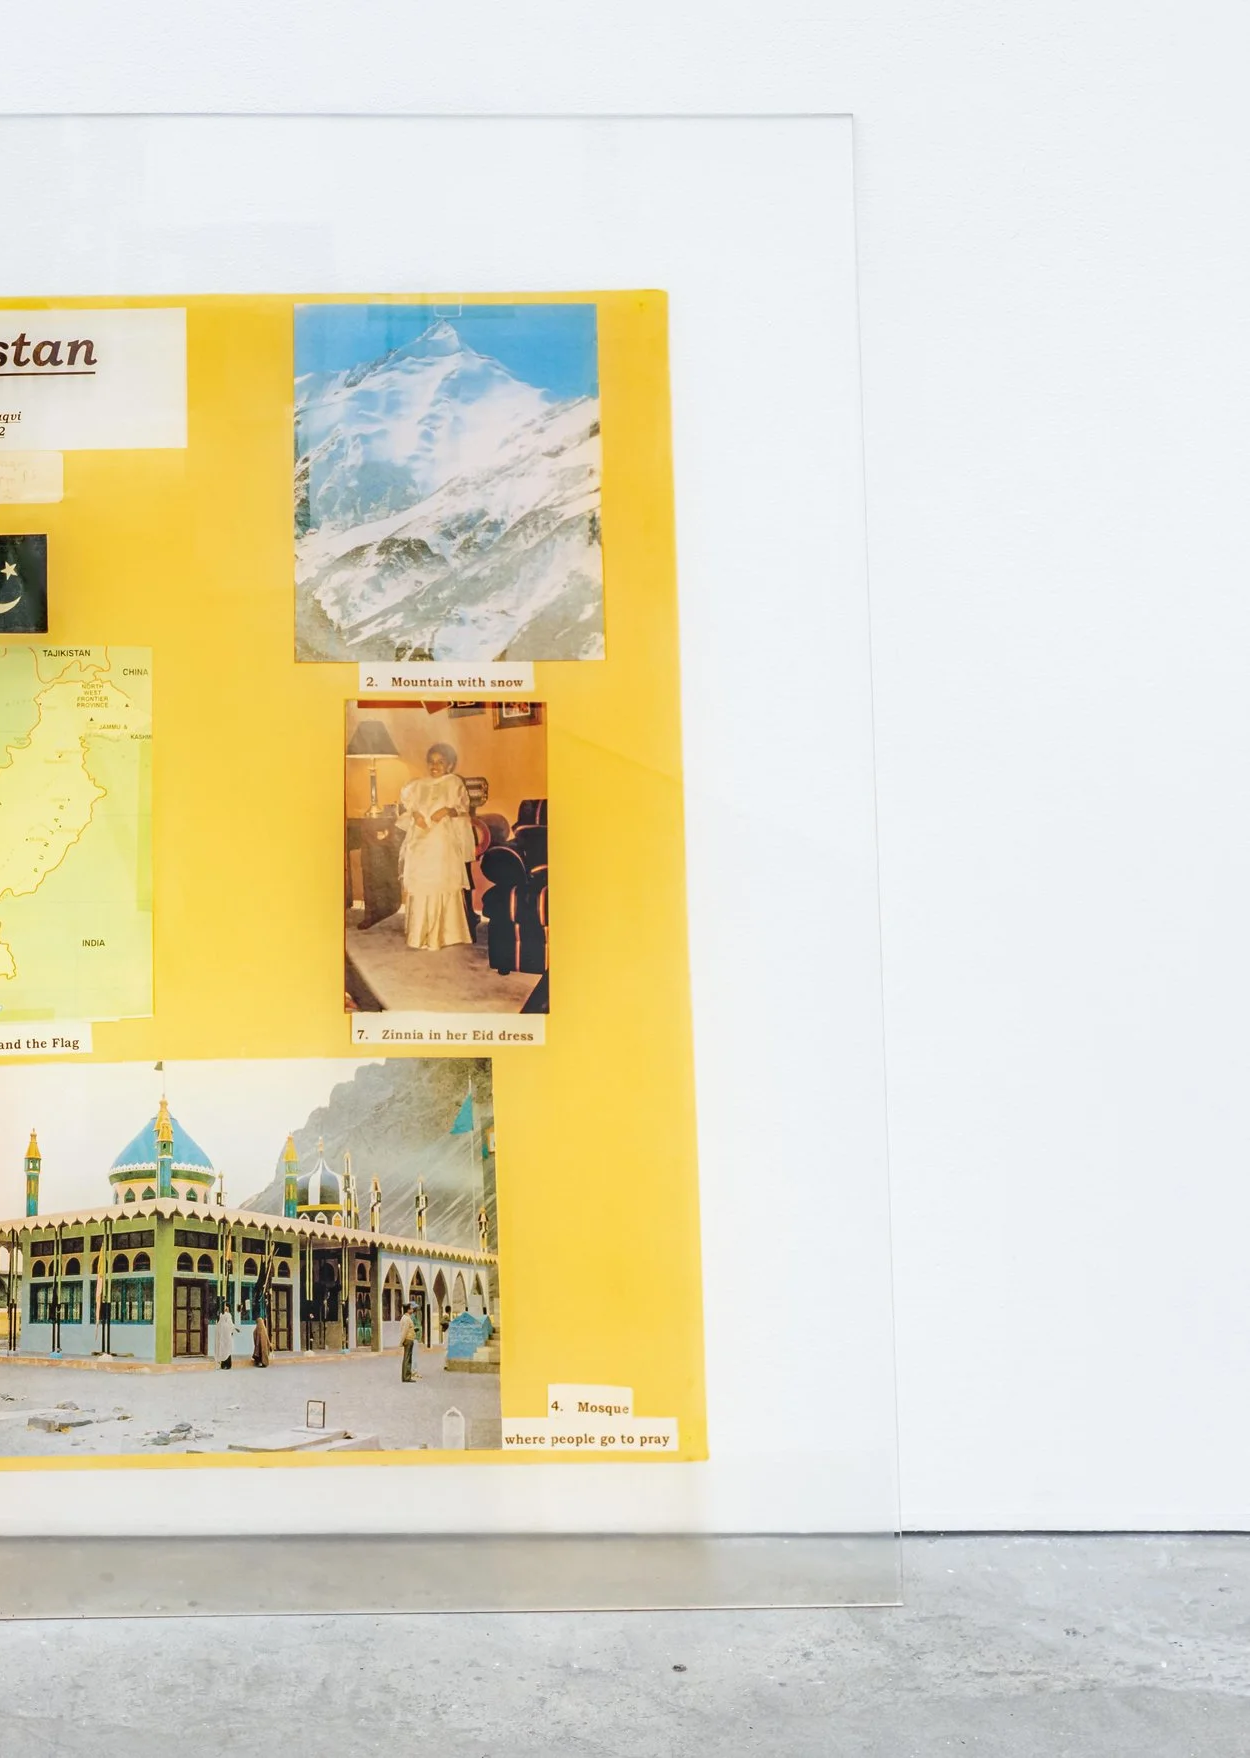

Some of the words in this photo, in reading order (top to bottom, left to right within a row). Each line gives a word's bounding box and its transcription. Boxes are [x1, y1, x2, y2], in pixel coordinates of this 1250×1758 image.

[366, 677, 378, 687] 2.
[391, 677, 453, 687] Mountain
[458, 677, 485, 687] with
[357, 1030, 368, 1039] 7.
[382, 1029, 424, 1040] Zinnia
[429, 1030, 441, 1040] in
[446, 1030, 467, 1040] her
[472, 1030, 493, 1040] Eid
[498, 1030, 534, 1041] dress
[26, 1039, 47, 1048] the
[52, 1038, 80, 1049] Flag
[551, 1401, 563, 1411] 4.
[577, 1402, 629, 1416] Mosque
[505, 1434, 545, 1444] where
[551, 1434, 595, 1447] people
[600, 1436, 615, 1446] go
[621, 1435, 634, 1444] to
[640, 1435, 670, 1447] pray
